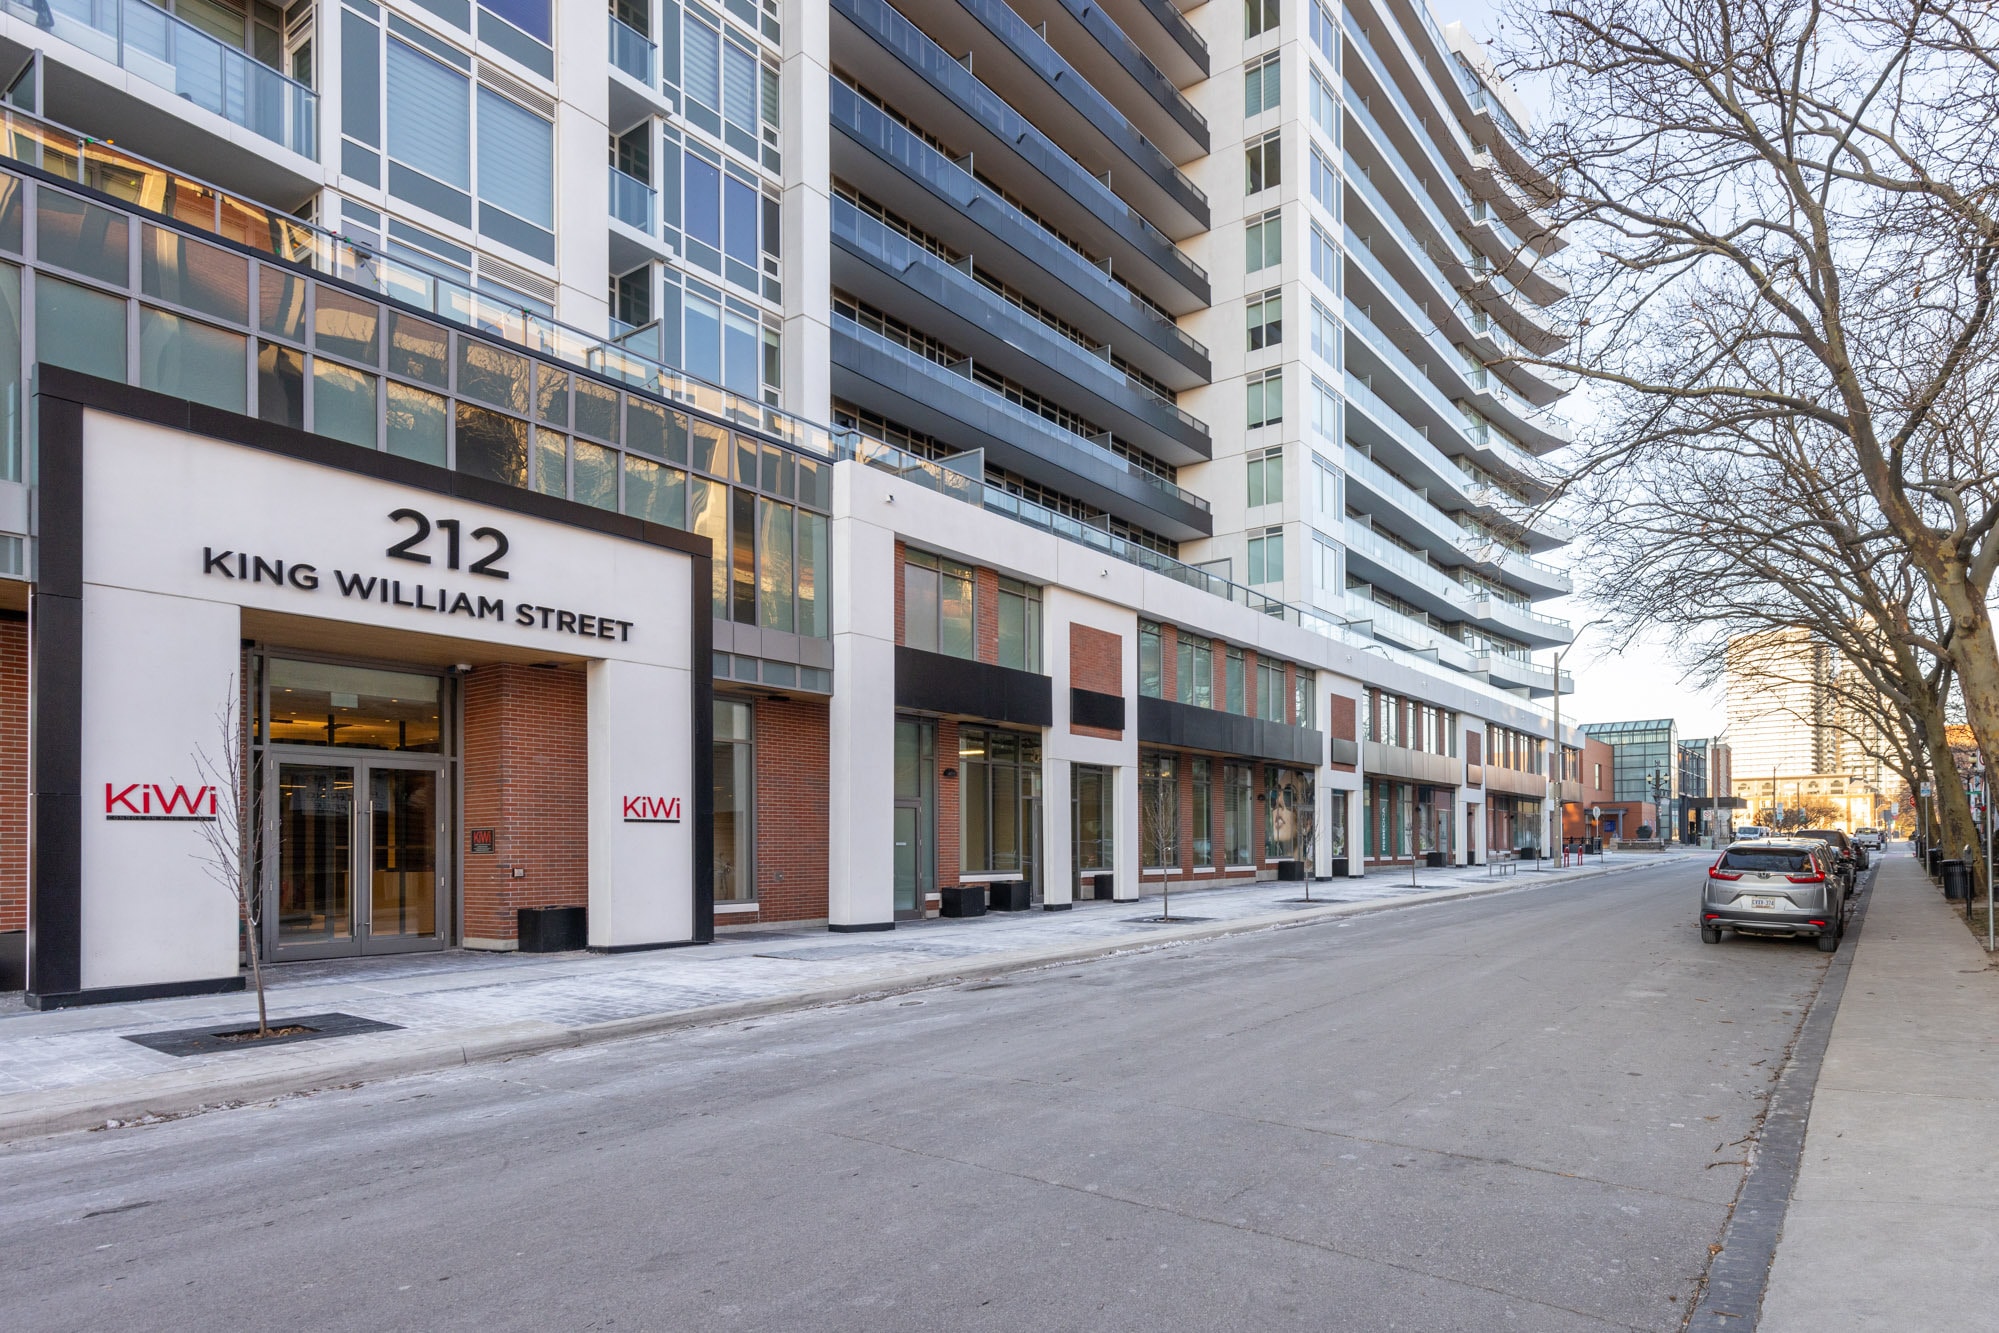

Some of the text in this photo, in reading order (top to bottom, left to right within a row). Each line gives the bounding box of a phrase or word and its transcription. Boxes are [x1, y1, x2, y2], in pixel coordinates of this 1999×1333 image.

[386, 508, 510, 580] 212
[203, 546, 634, 642] KING WILLIAM STREET
[106, 783, 217, 815] KiWi
[623, 796, 681, 819] KiWi
